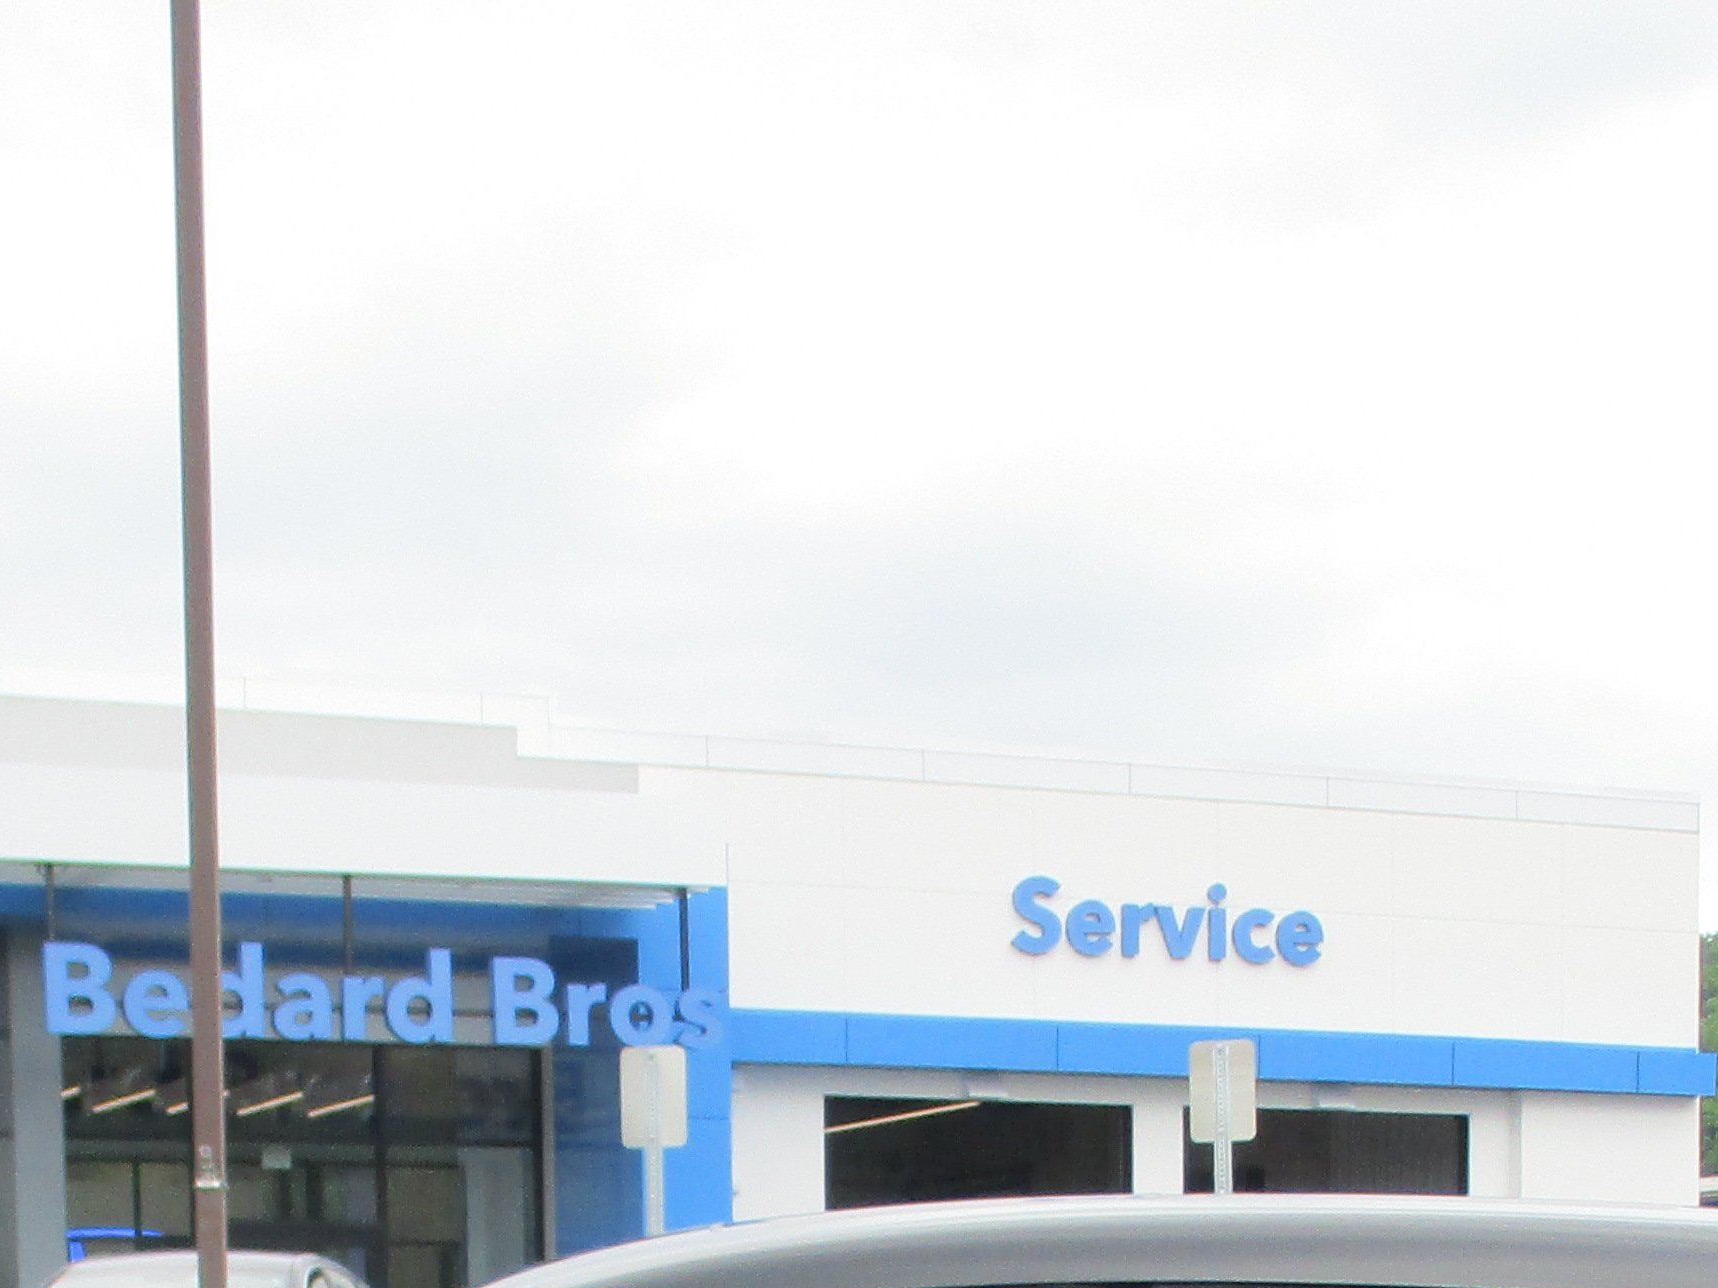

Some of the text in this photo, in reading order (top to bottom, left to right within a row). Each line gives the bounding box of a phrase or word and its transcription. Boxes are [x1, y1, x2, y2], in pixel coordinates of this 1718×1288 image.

[1010, 875, 1325, 968] Service
[43, 940, 726, 1048] Bedard Bros
